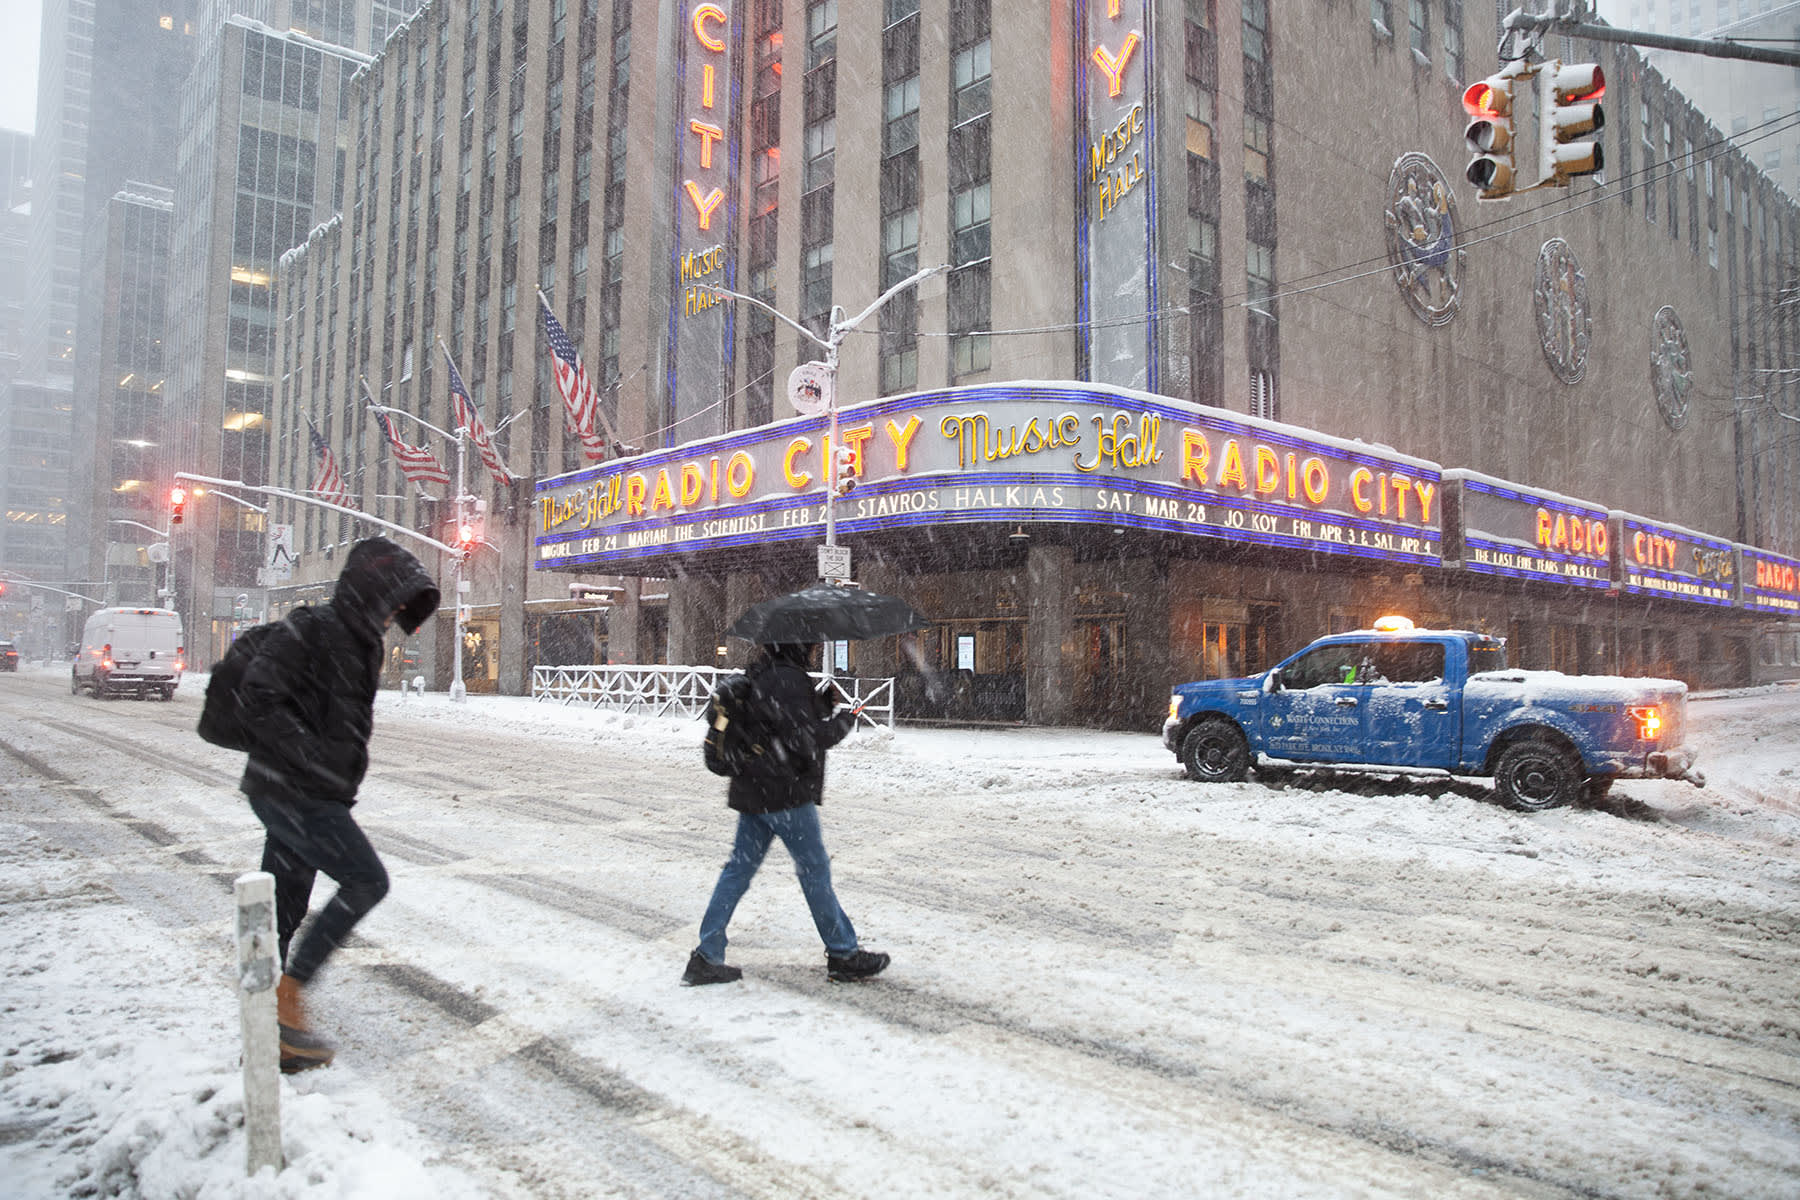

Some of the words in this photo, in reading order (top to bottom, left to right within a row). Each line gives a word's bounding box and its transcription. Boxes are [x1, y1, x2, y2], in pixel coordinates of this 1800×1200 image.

[685, 3, 727, 231] CITY
[1091, 105, 1143, 182] MUSIC
[1099, 152, 1144, 221] HALL
[679, 246, 723, 285] MUSIC
[685, 281, 721, 318] HALL
[939, 411, 1081, 469] Music
[1073, 411, 1164, 472] Hall
[626, 451, 757, 517] RADIO
[783, 415, 921, 489] CITY
[1181, 427, 1329, 504] RADIO
[1350, 467, 1436, 524] CITY
[540, 488, 584, 533] Music
[579, 473, 624, 529] Hall
[857, 490, 938, 519] STAVROS
[955, 486, 1064, 508] HALKIAS
[1145, 496, 1179, 520] MAR
[1188, 503, 1206, 523] 28
[541, 542, 571, 559] MIGUEL
[582, 538, 600, 554] FEB
[604, 535, 618, 551] 24
[627, 528, 669, 548] MARIAH
[675, 524, 694, 542] THE
[702, 513, 767, 538] SCIENTIST
[783, 508, 809, 528] FEB
[1224, 509, 1244, 529] JO
[1251, 513, 1278, 533] KOY
[1320, 524, 1342, 542] APR
[1349, 529, 1356, 545] 3
[1361, 530, 1369, 547] &
[1374, 532, 1394, 550] SAT
[1401, 537, 1420, 554] APR
[1424, 541, 1431, 555] 4
[1536, 508, 1608, 557] RADIO
[1474, 548, 1489, 563] THE
[1493, 551, 1513, 568] LAST
[1633, 531, 1677, 570] CITY
[1756, 560, 1795, 592] RADIO
